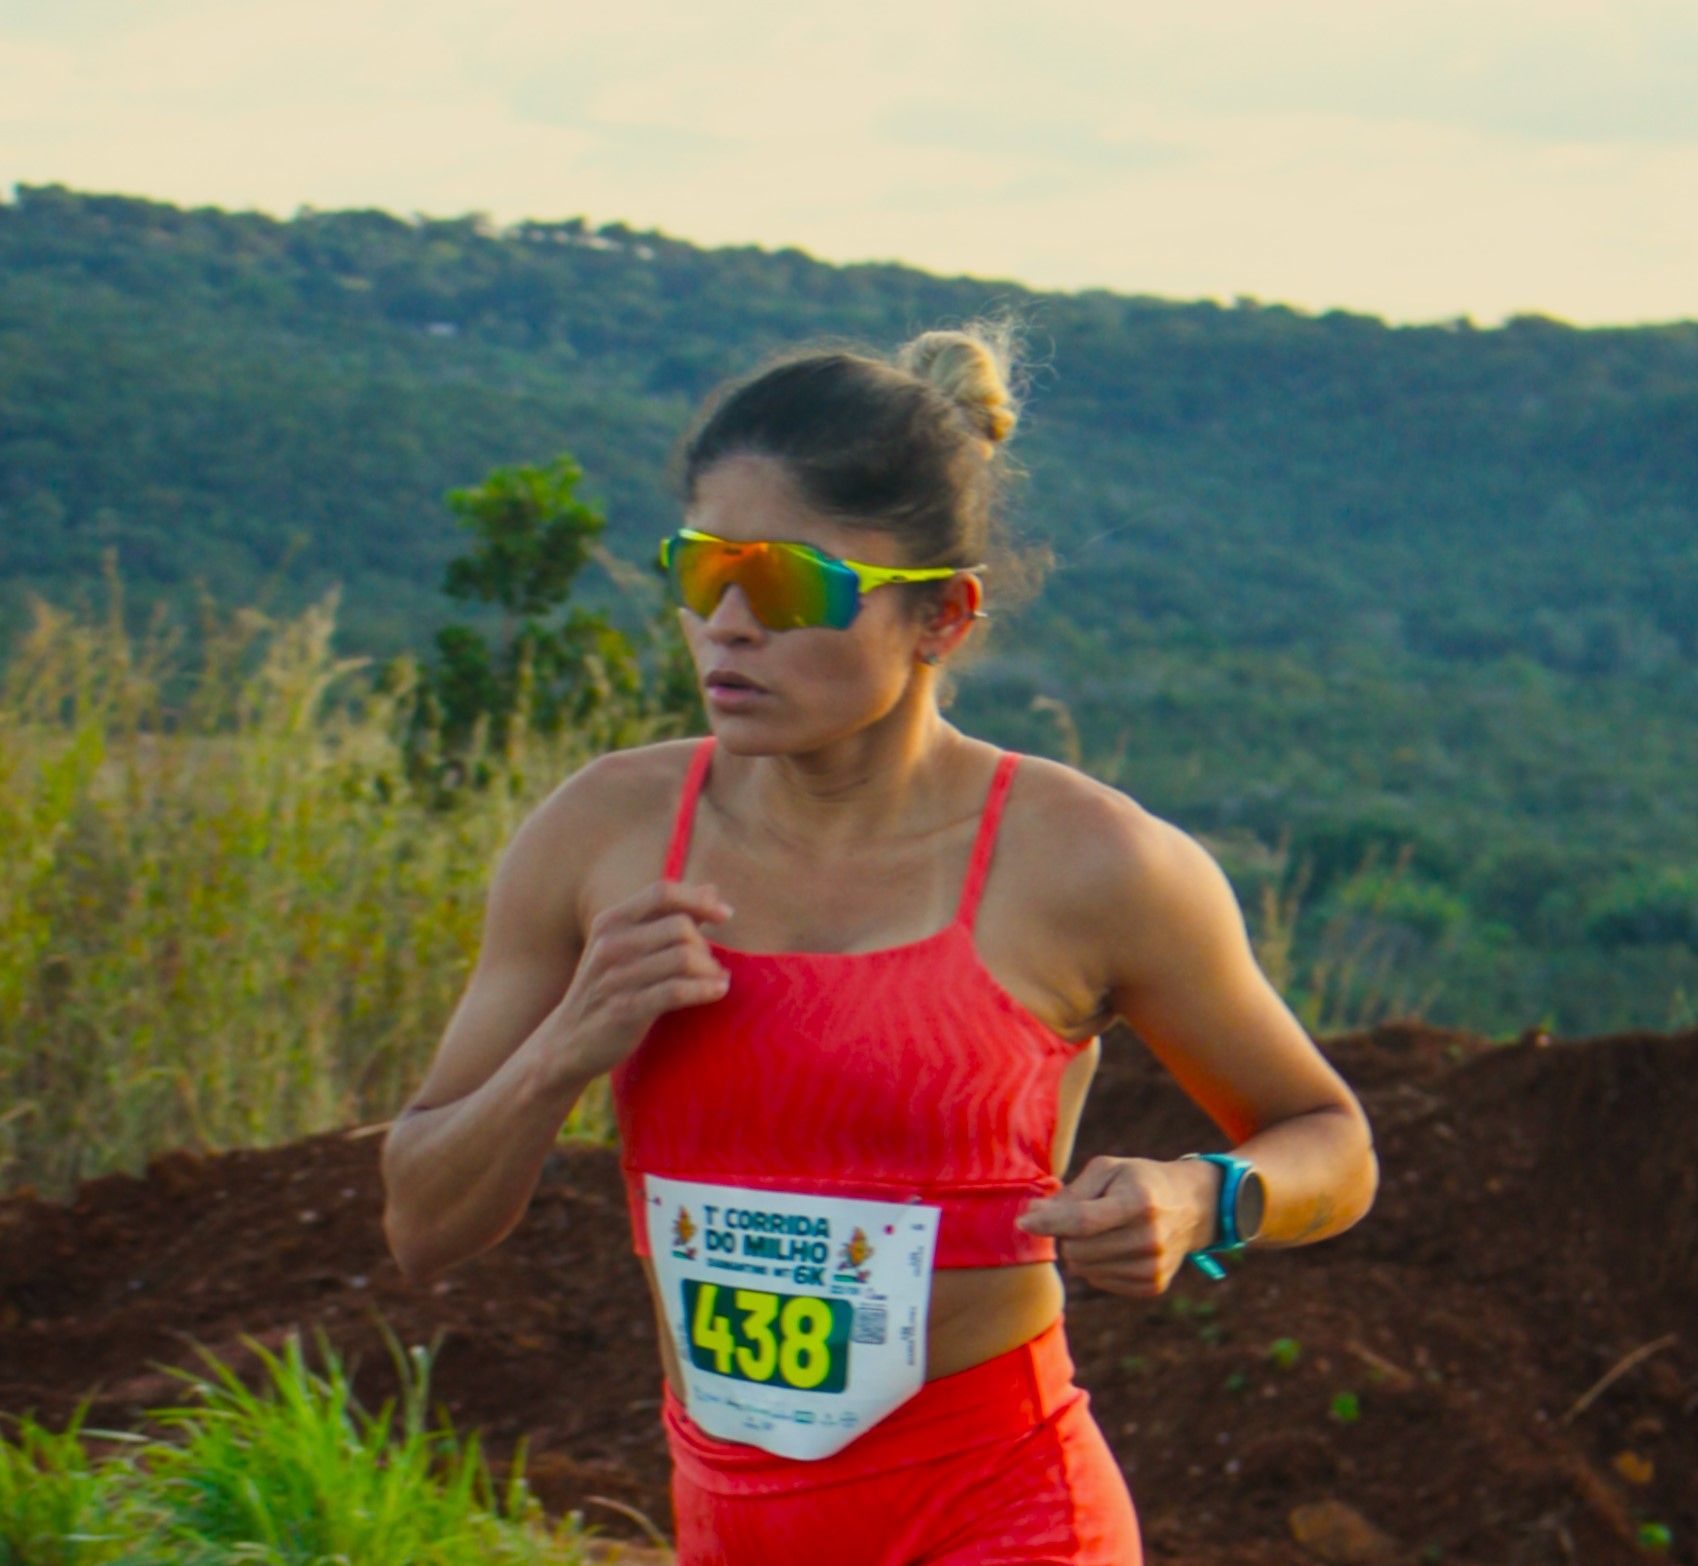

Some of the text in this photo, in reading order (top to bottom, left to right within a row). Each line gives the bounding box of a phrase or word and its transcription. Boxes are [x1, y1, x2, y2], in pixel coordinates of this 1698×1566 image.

[725, 1208, 829, 1238] CORRIDA
[705, 1229, 828, 1264] DO MILHO
[793, 1265, 825, 1285] 6K
[693, 1283, 833, 1389] 438
